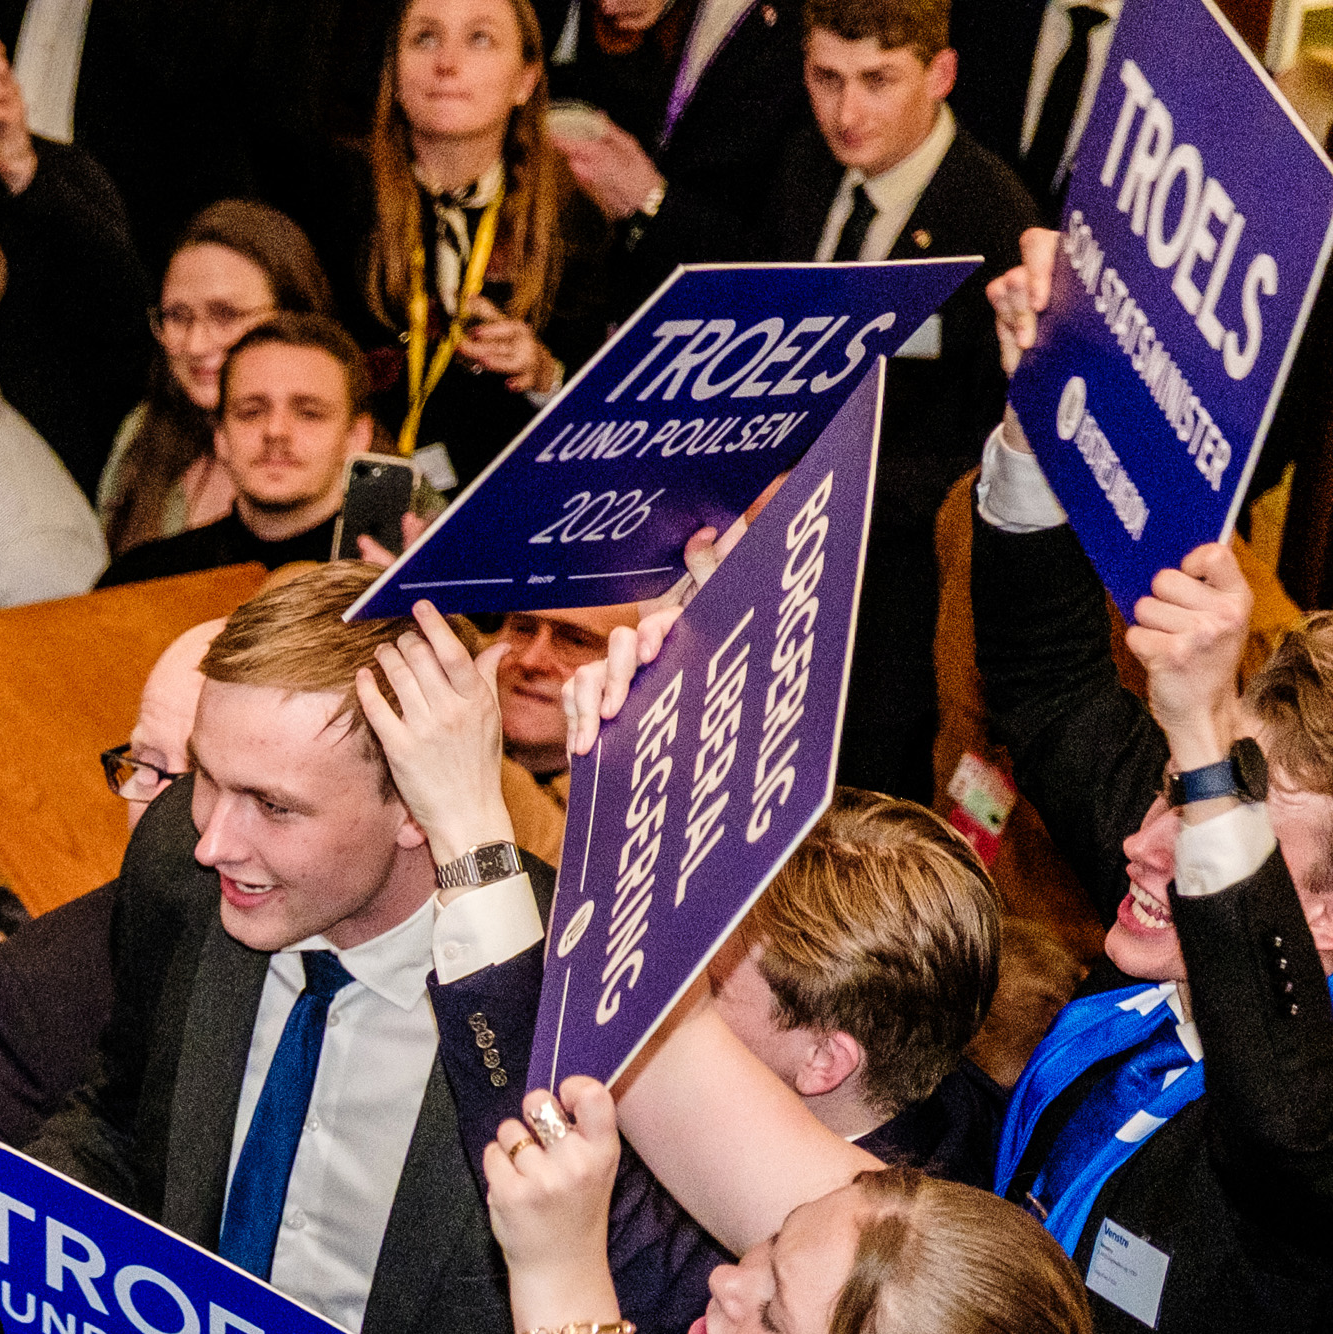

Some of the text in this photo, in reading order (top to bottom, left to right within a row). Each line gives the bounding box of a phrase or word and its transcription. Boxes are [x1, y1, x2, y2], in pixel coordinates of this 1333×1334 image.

[605, 311, 896, 403] TROELS
[1100, 58, 1278, 380] TROELS
[528, 488, 666, 544] 2026
[535, 411, 809, 463] LUND POULSEN
[675, 607, 754, 908] LIBERAL
[746, 469, 833, 844] BORGERLIG
[595, 669, 683, 1026] REGERING
